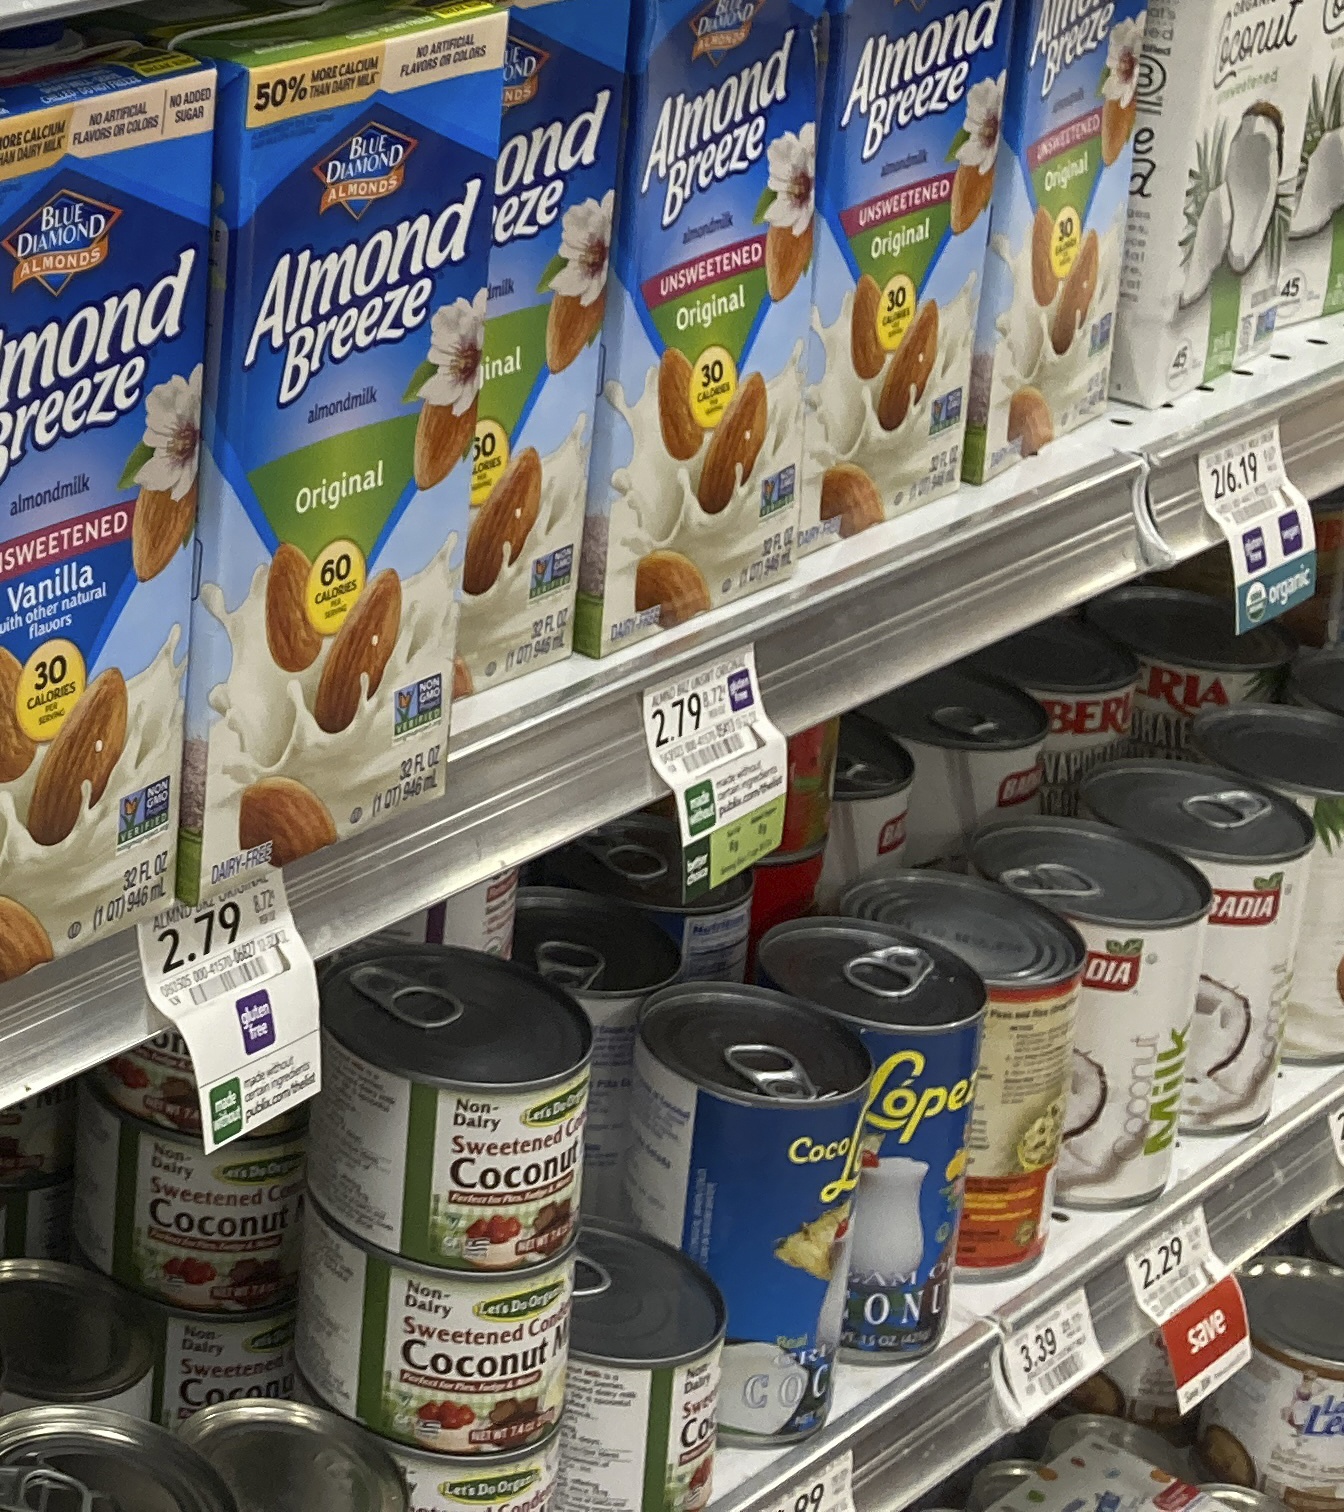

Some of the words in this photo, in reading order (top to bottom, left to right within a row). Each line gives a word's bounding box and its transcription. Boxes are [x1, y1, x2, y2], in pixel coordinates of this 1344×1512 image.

[641, 29, 795, 194] Almond
[662, 116, 765, 227] Breeze
[858, 180, 950, 227] UNSWEETENED
[871, 218, 930, 260] Original
[245, 179, 482, 366] Almond
[1282, 277, 1300, 299] 45
[887, 286, 906, 312] 30
[279, 277, 432, 404] Breeze
[295, 459, 385, 515] Original
[1211, 452, 1257, 499] 2/6.19
[320, 554, 352, 587] 60
[1268, 568, 1310, 605] organic
[652, 692, 702, 748] 2.79
[157, 901, 242, 974] 2.79
[453, 1113, 501, 1133] Dairy
[455, 1098, 500, 1116] Non-
[449, 1148, 578, 1191] Coconut
[788, 1135, 849, 1165] Coco
[1139, 1237, 1183, 1289] 2.29
[402, 1317, 526, 1346] Sweetened
[1020, 1328, 1057, 1373] 3.39
[1187, 1307, 1227, 1355] save
[400, 1339, 547, 1378] Coconut
